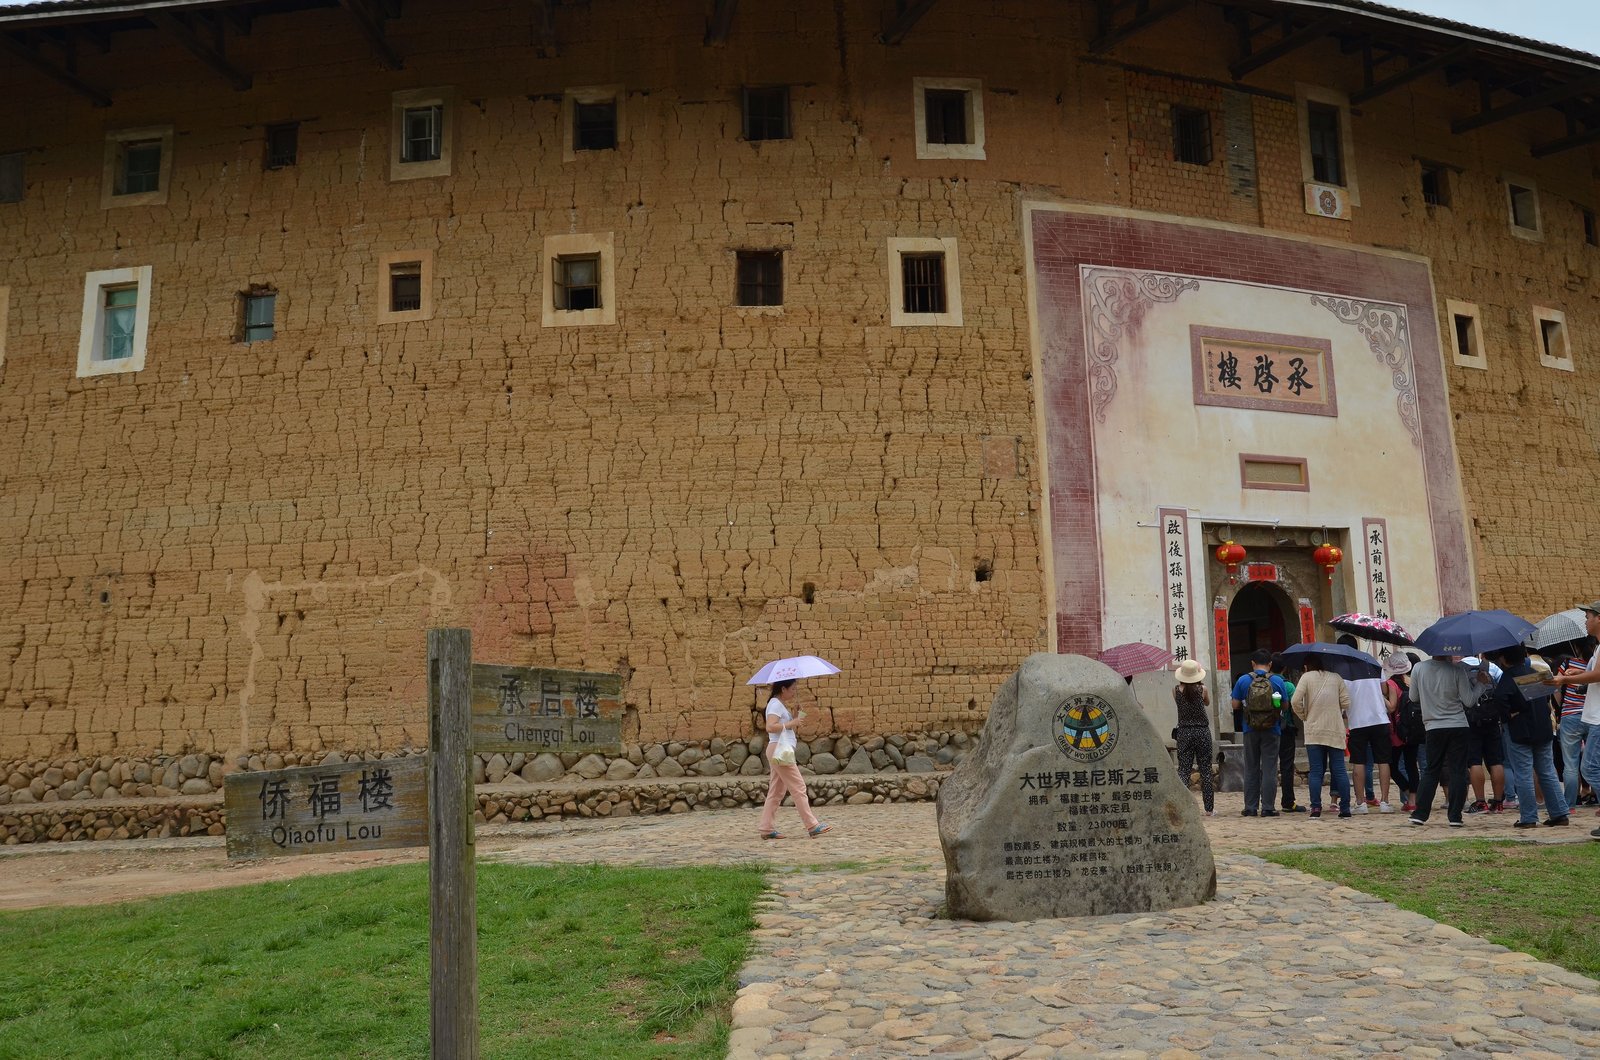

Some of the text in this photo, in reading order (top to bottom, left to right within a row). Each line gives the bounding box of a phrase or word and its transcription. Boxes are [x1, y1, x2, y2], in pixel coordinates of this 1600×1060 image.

[505, 719, 595, 747] Chengqi Lou
[1074, 751, 1099, 760] WORLD
[1019, 767, 1159, 790] 大世界基尼斯之最
[259, 768, 393, 821] 侨福楼
[271, 821, 382, 847] Qiaofu Lou
